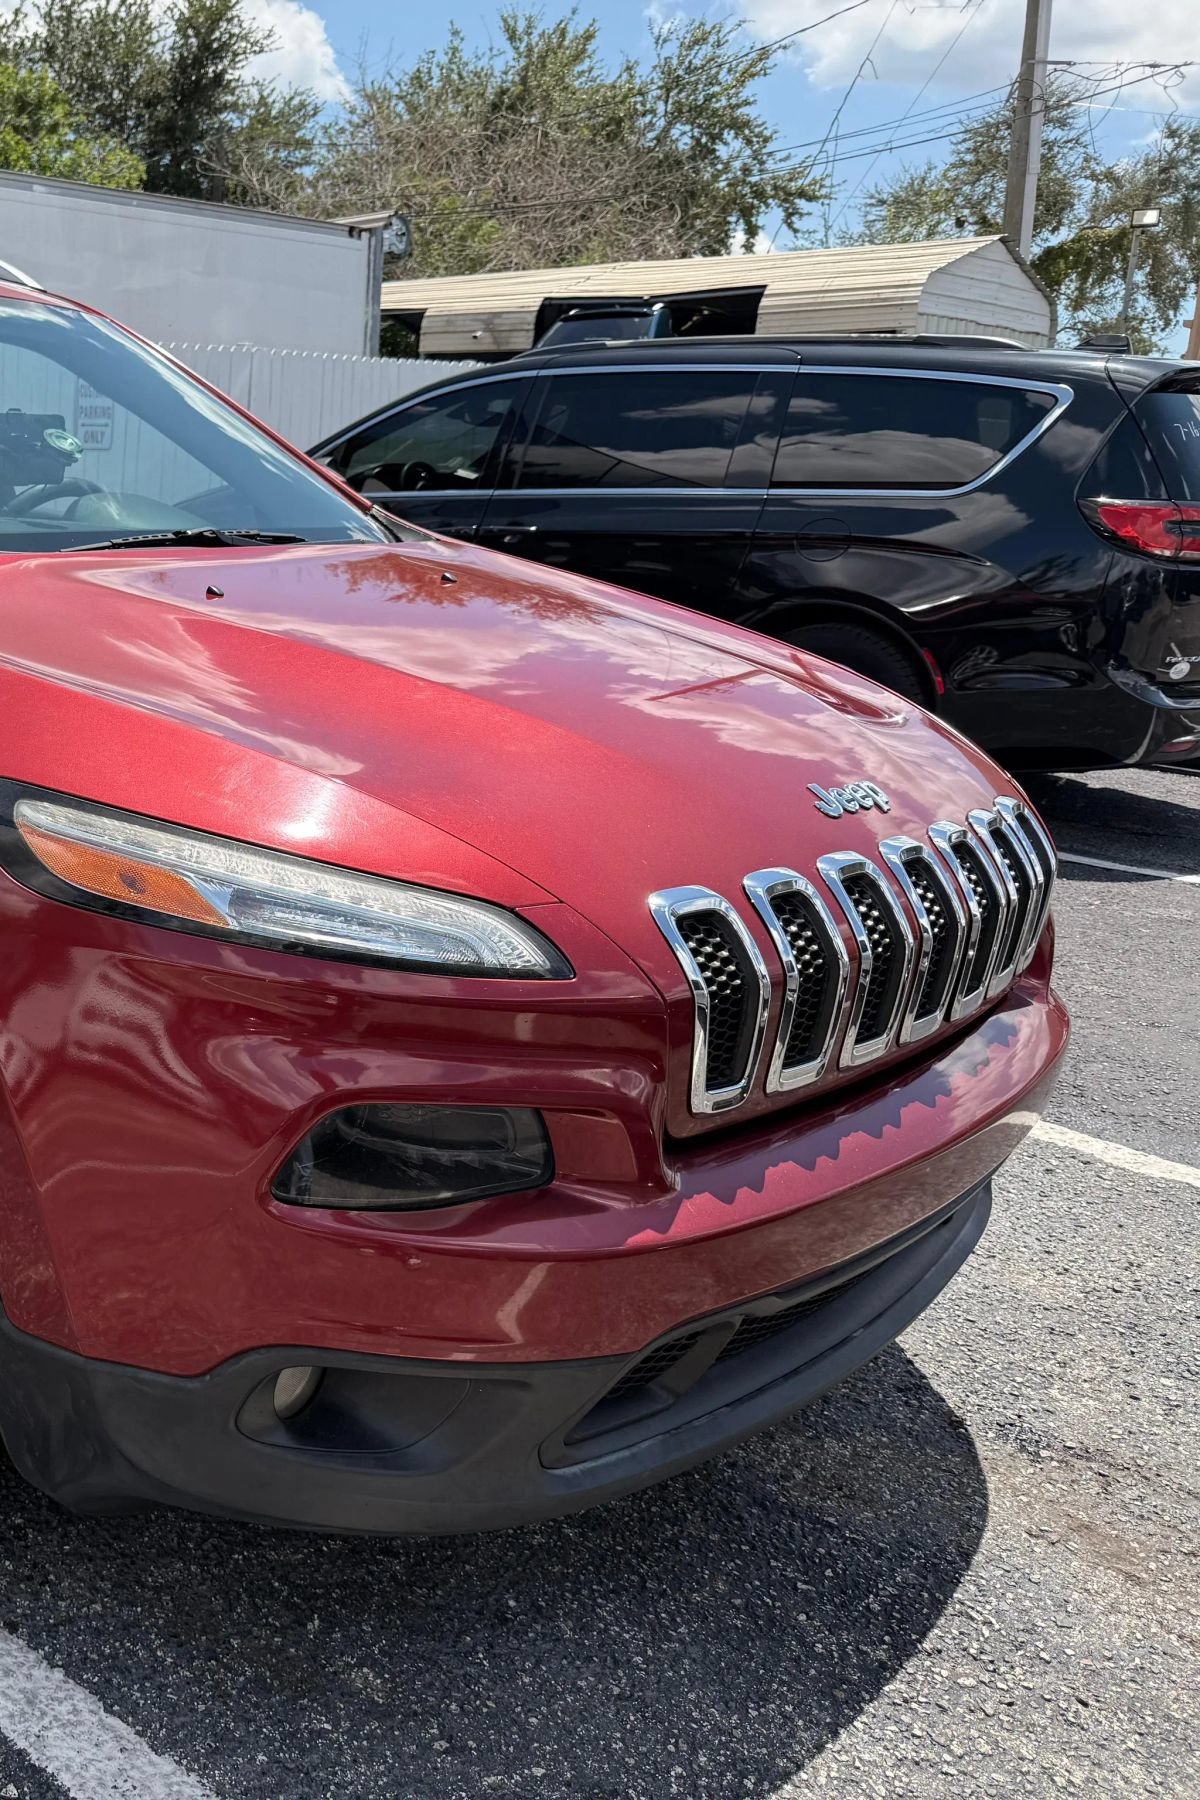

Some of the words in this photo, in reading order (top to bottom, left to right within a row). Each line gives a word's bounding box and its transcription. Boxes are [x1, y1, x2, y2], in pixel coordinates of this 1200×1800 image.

[80, 405, 111, 419] PARKING
[84, 430, 106, 444] ONLY
[806, 780, 891, 818] Jeep
